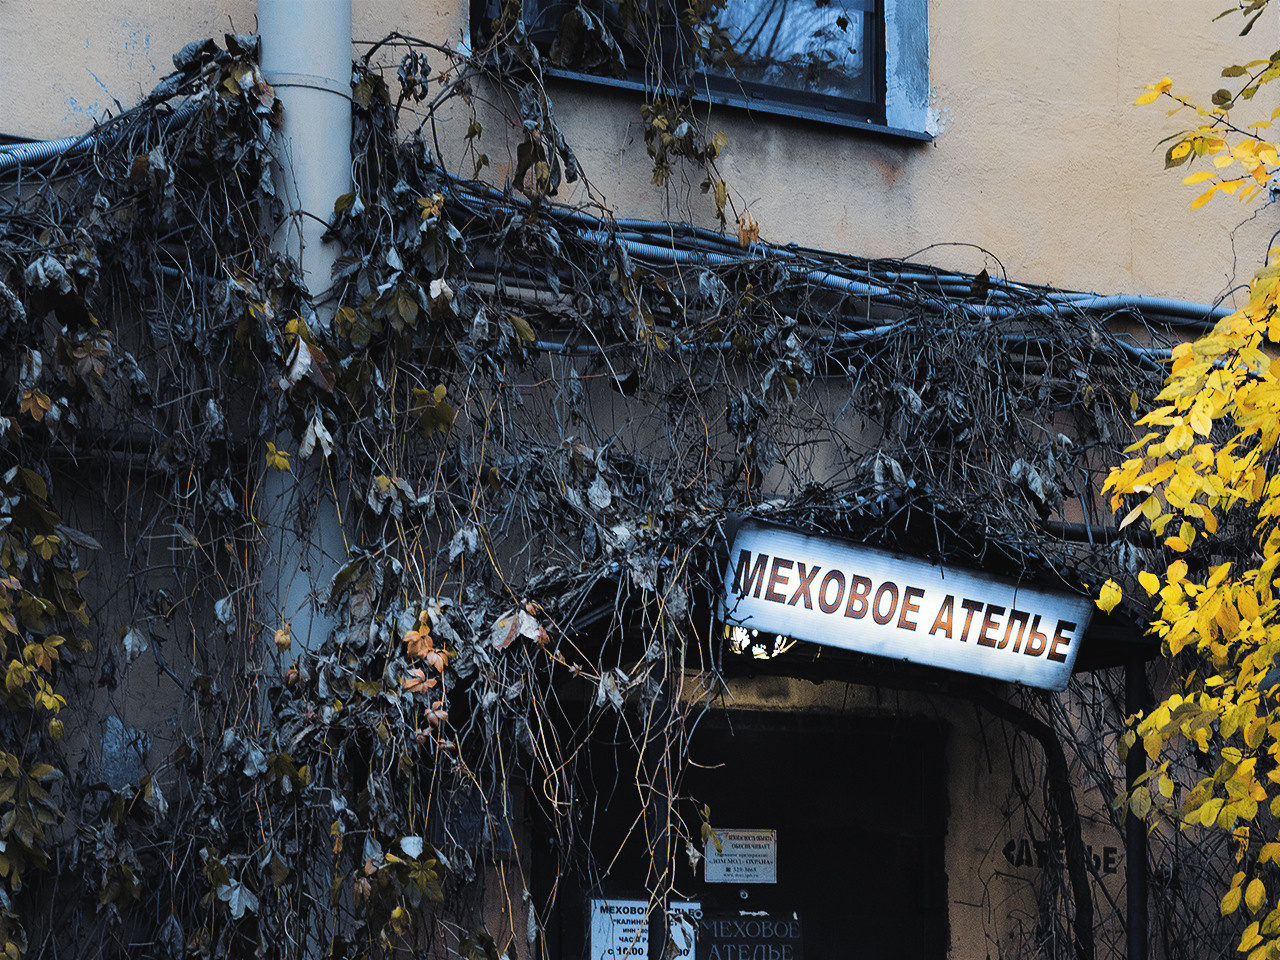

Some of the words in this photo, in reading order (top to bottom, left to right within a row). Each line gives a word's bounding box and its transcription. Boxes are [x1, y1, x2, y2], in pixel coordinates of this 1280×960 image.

[731, 549, 925, 632] МЕХОВОЕ
[929, 594, 1077, 664] АТЕЛЬЕ
[700, 920, 801, 938] МЕХОВОЕ
